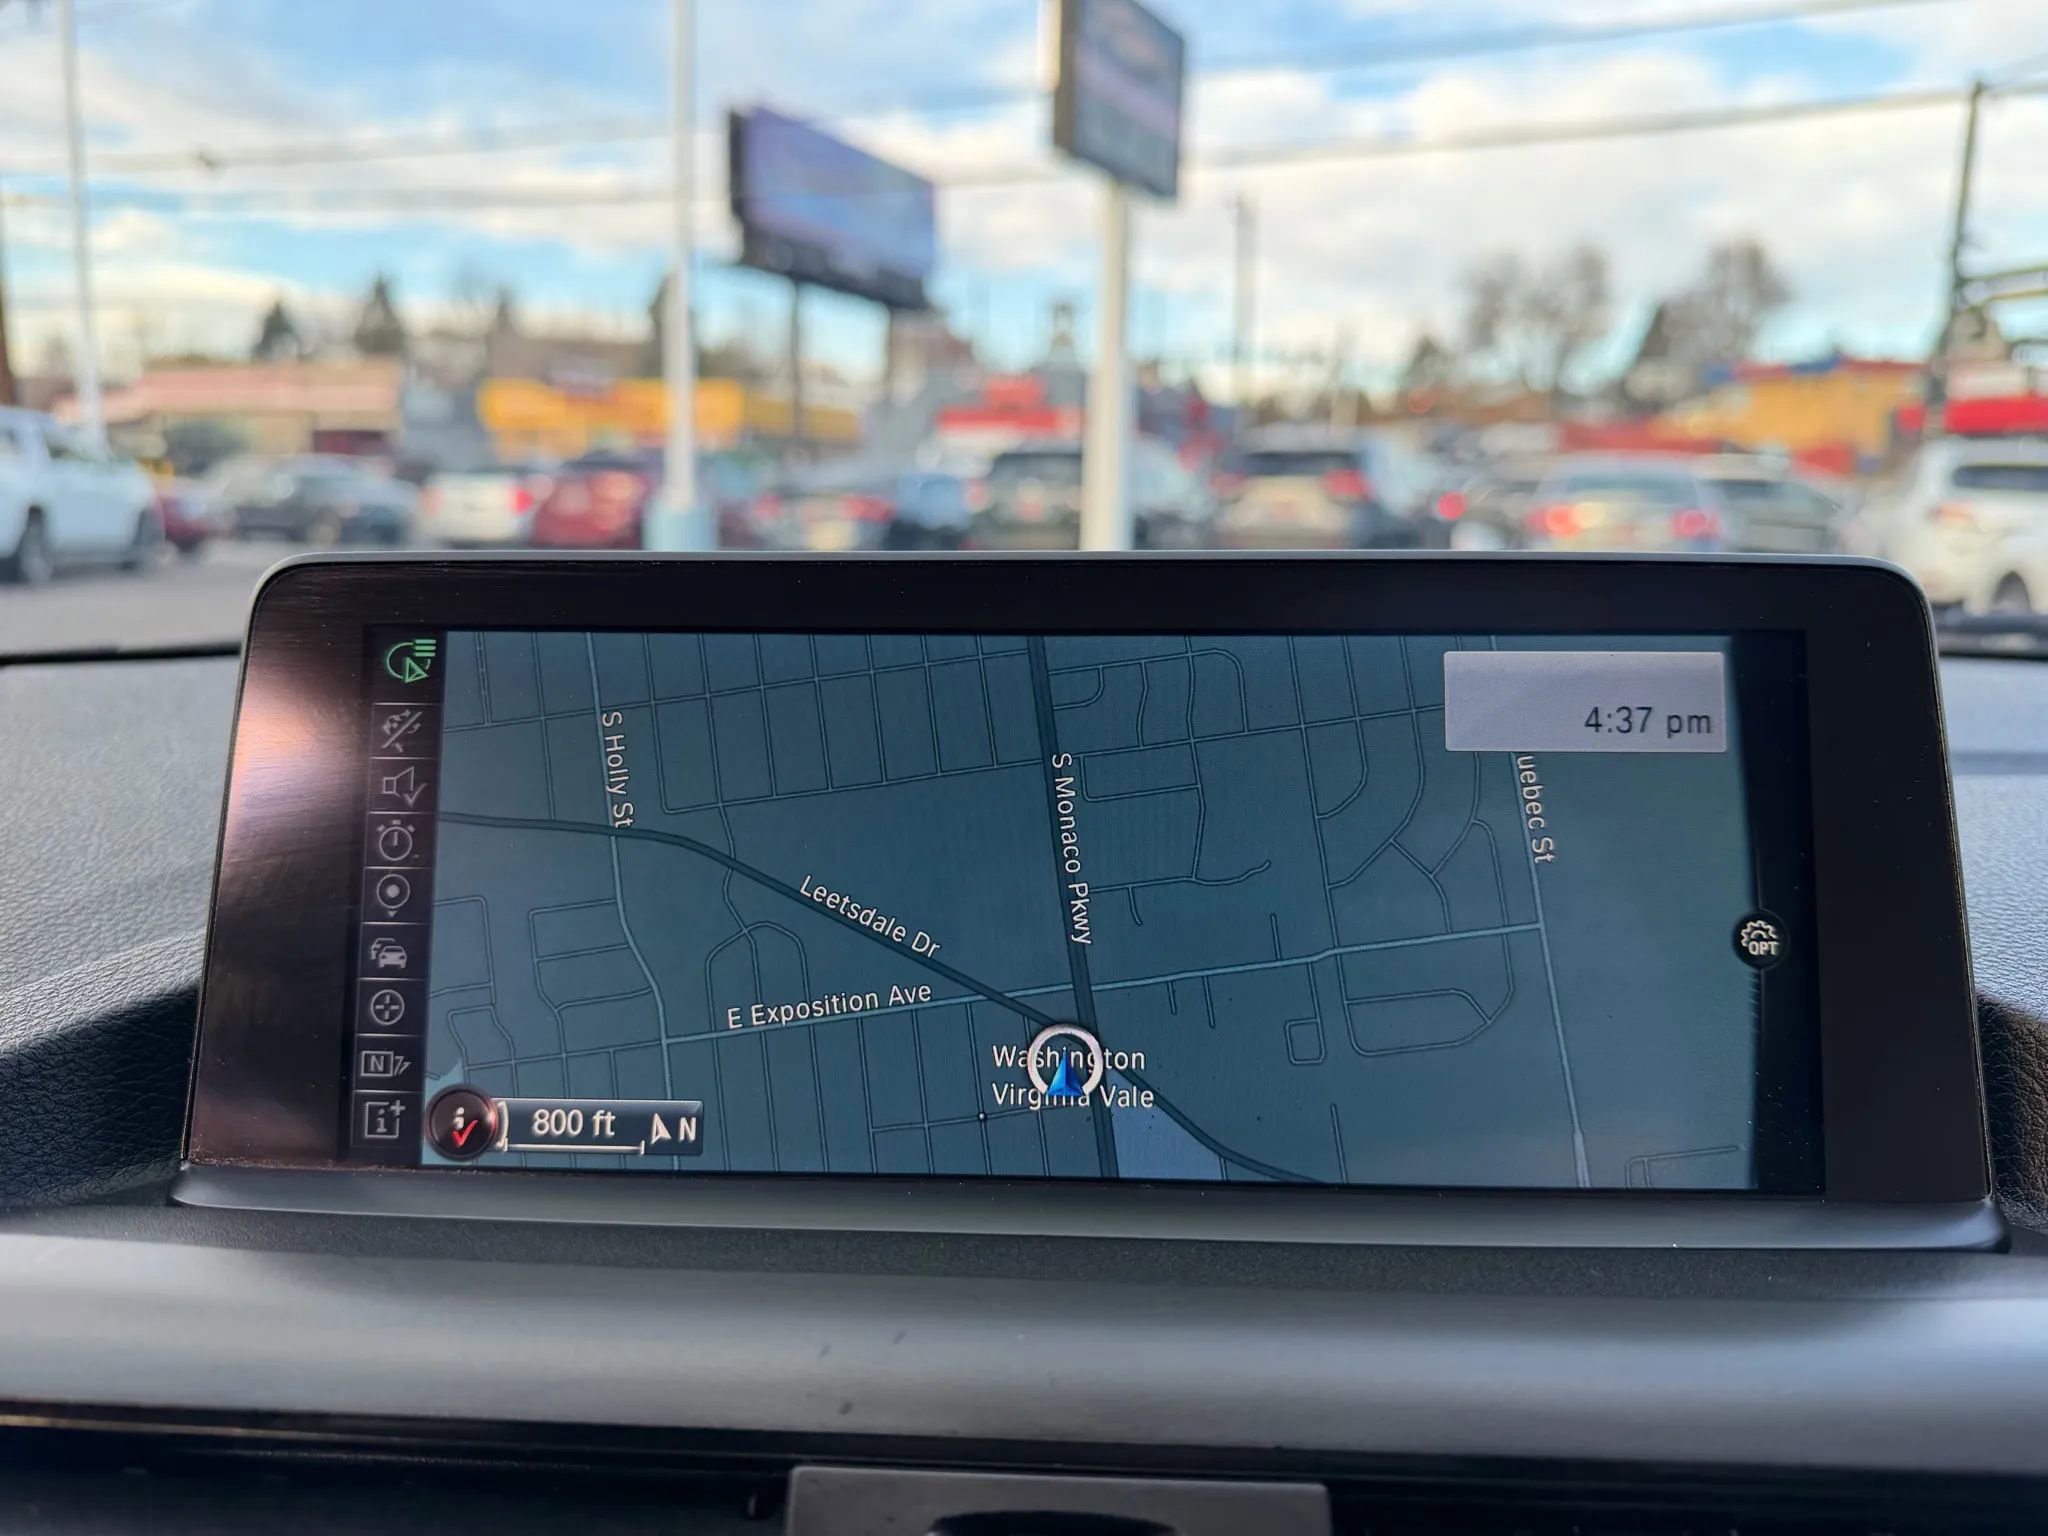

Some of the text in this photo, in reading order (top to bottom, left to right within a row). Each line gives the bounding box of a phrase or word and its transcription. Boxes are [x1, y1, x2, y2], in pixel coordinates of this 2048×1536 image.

[1584, 706, 1712, 738] 4:37 pm
[602, 711, 634, 829] S Holly St
[1517, 755, 1555, 864] uebec St
[1052, 753, 1092, 945] S Monaco Pkwy
[800, 875, 941, 958] Leetsdale Dr
[1748, 940, 1779, 956] OPT
[728, 984, 931, 1029] E Exposition Ave
[993, 1045, 1146, 1072] Washngton
[1100, 1085, 1155, 1108] Vale
[533, 1109, 616, 1137] 800 ft
[679, 1117, 696, 1142] N
